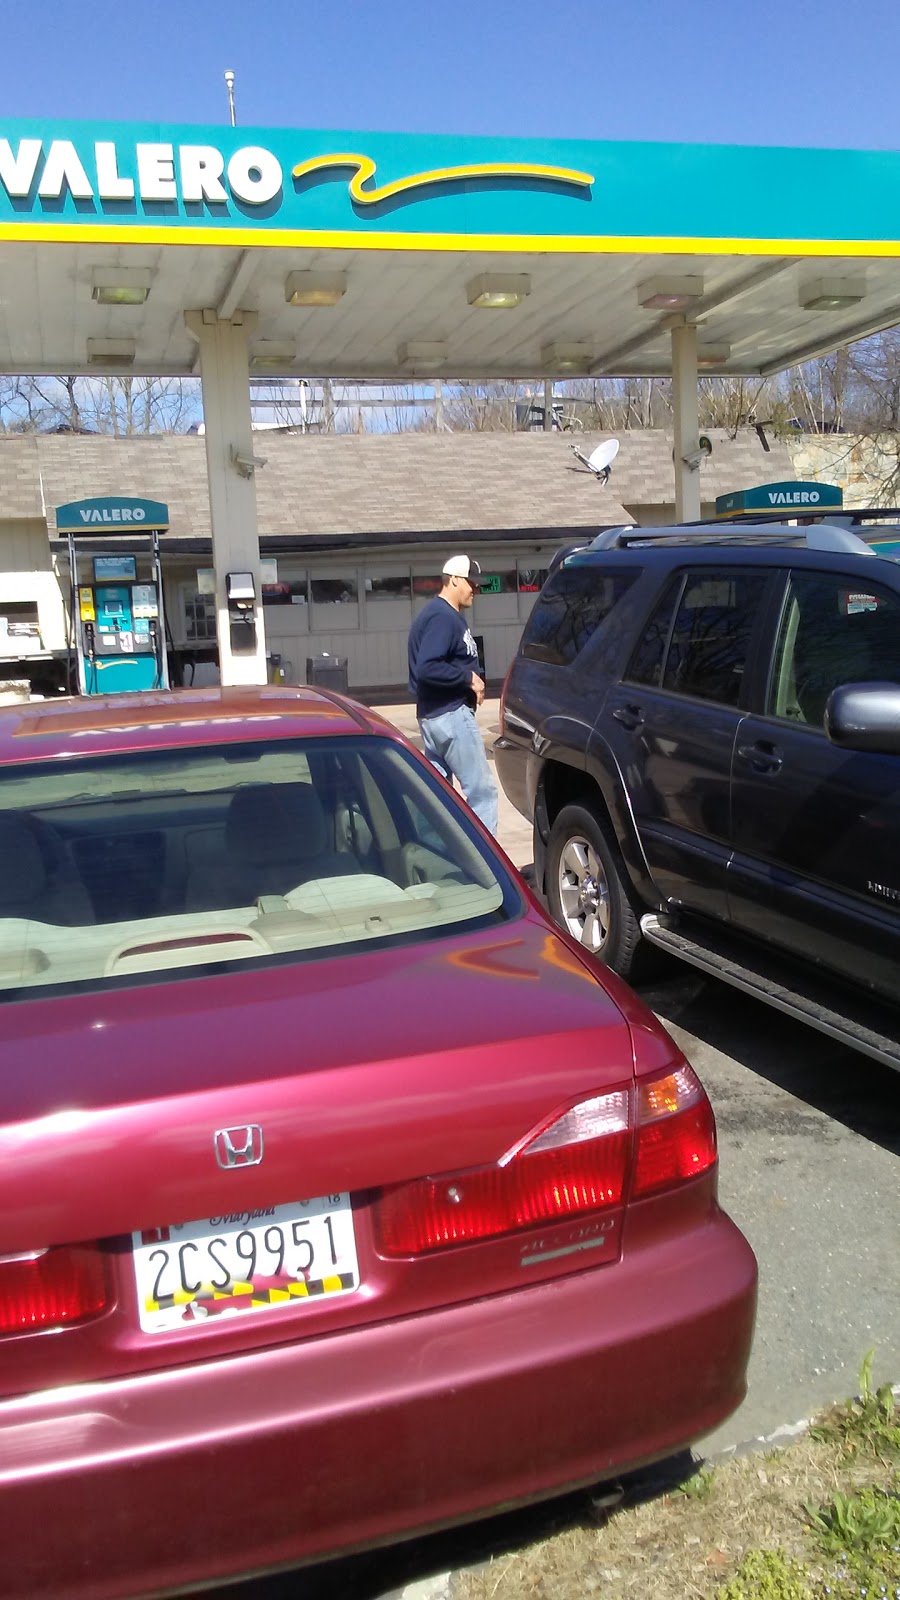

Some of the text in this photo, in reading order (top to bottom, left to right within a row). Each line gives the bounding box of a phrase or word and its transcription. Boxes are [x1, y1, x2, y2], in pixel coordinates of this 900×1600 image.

[0, 139, 283, 206] VALERO
[79, 507, 146, 522] VALERO
[768, 491, 820, 504] VALERO
[148, 1215, 338, 1303] 2CS9951
